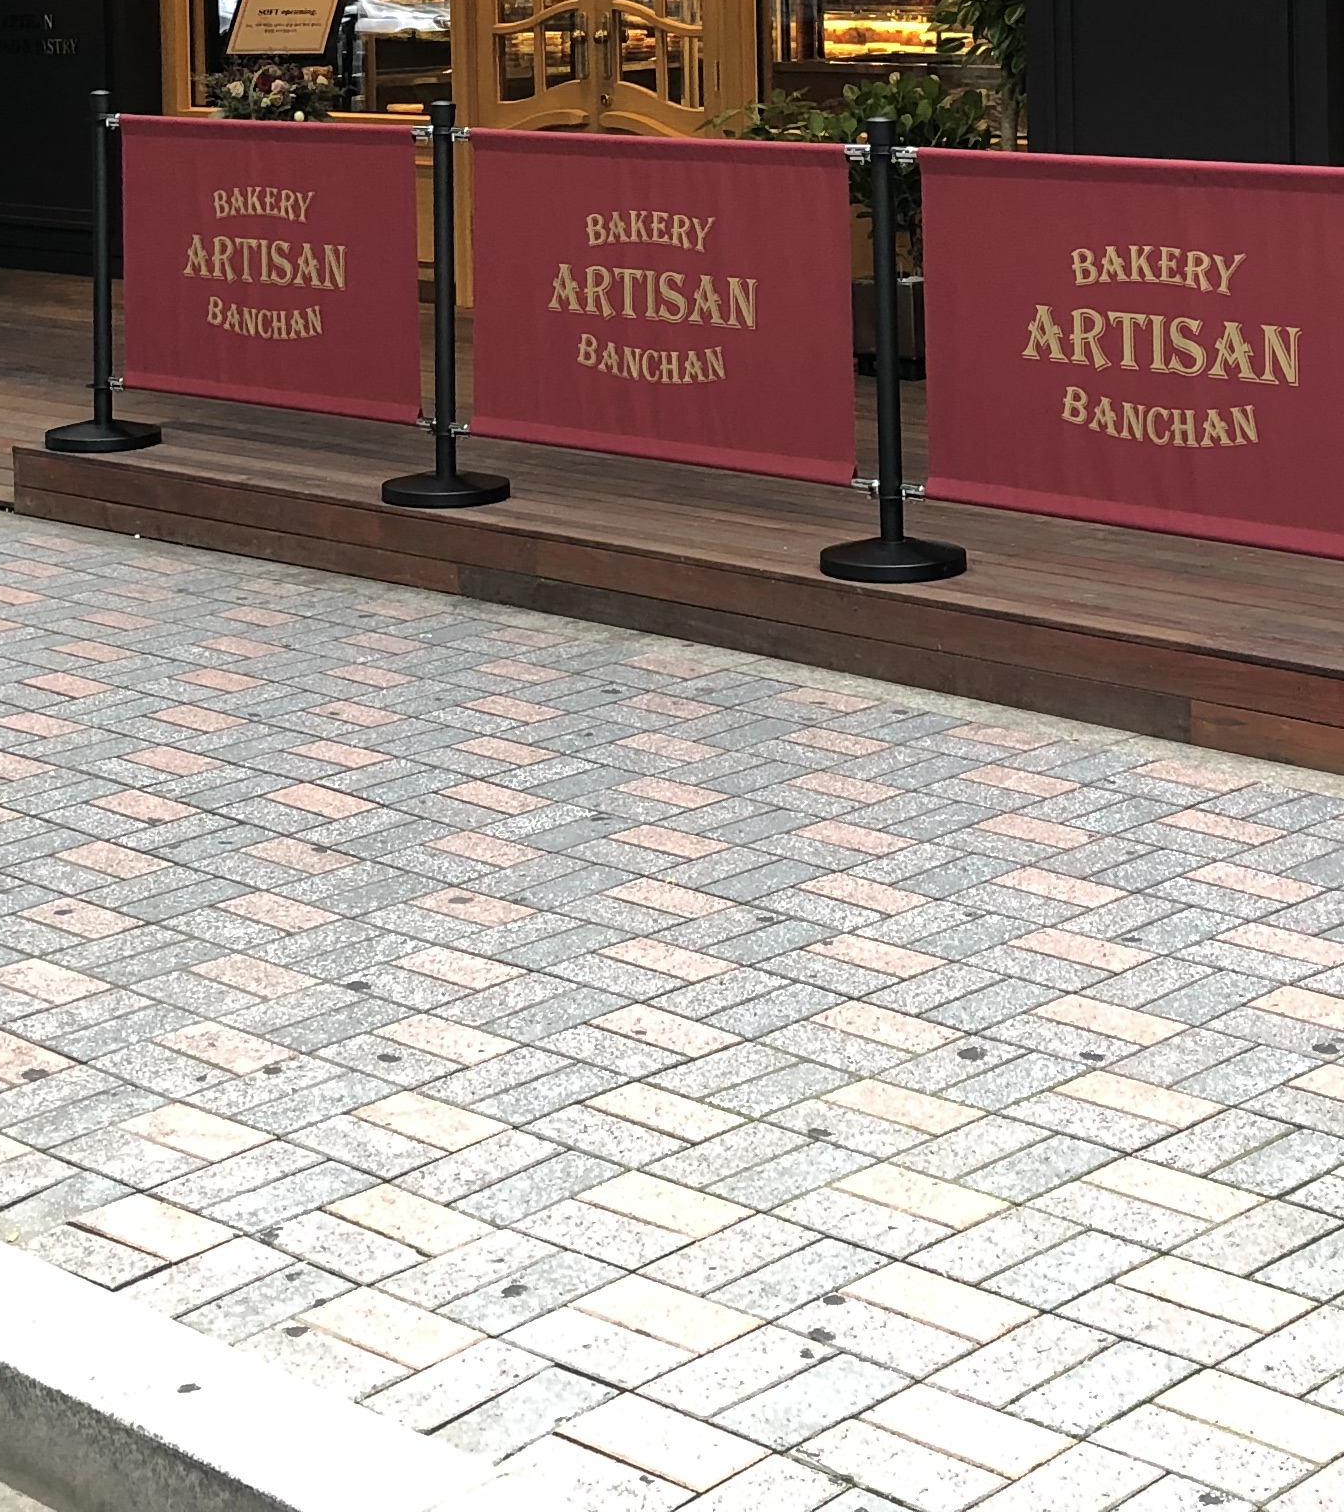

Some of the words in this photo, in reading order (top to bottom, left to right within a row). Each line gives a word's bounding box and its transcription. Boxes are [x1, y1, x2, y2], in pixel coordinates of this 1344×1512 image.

[213, 186, 314, 223] BAKERY
[586, 210, 716, 253] BAKERY
[183, 235, 346, 291] ARTISAN
[1071, 245, 1246, 296] BAKERY
[206, 296, 323, 341] BANCHAN
[548, 263, 757, 331] ARTISAN
[577, 334, 726, 384] BANCHAN
[1022, 305, 1302, 387] ARTISAN
[1061, 386, 1259, 448] BANCHAN
